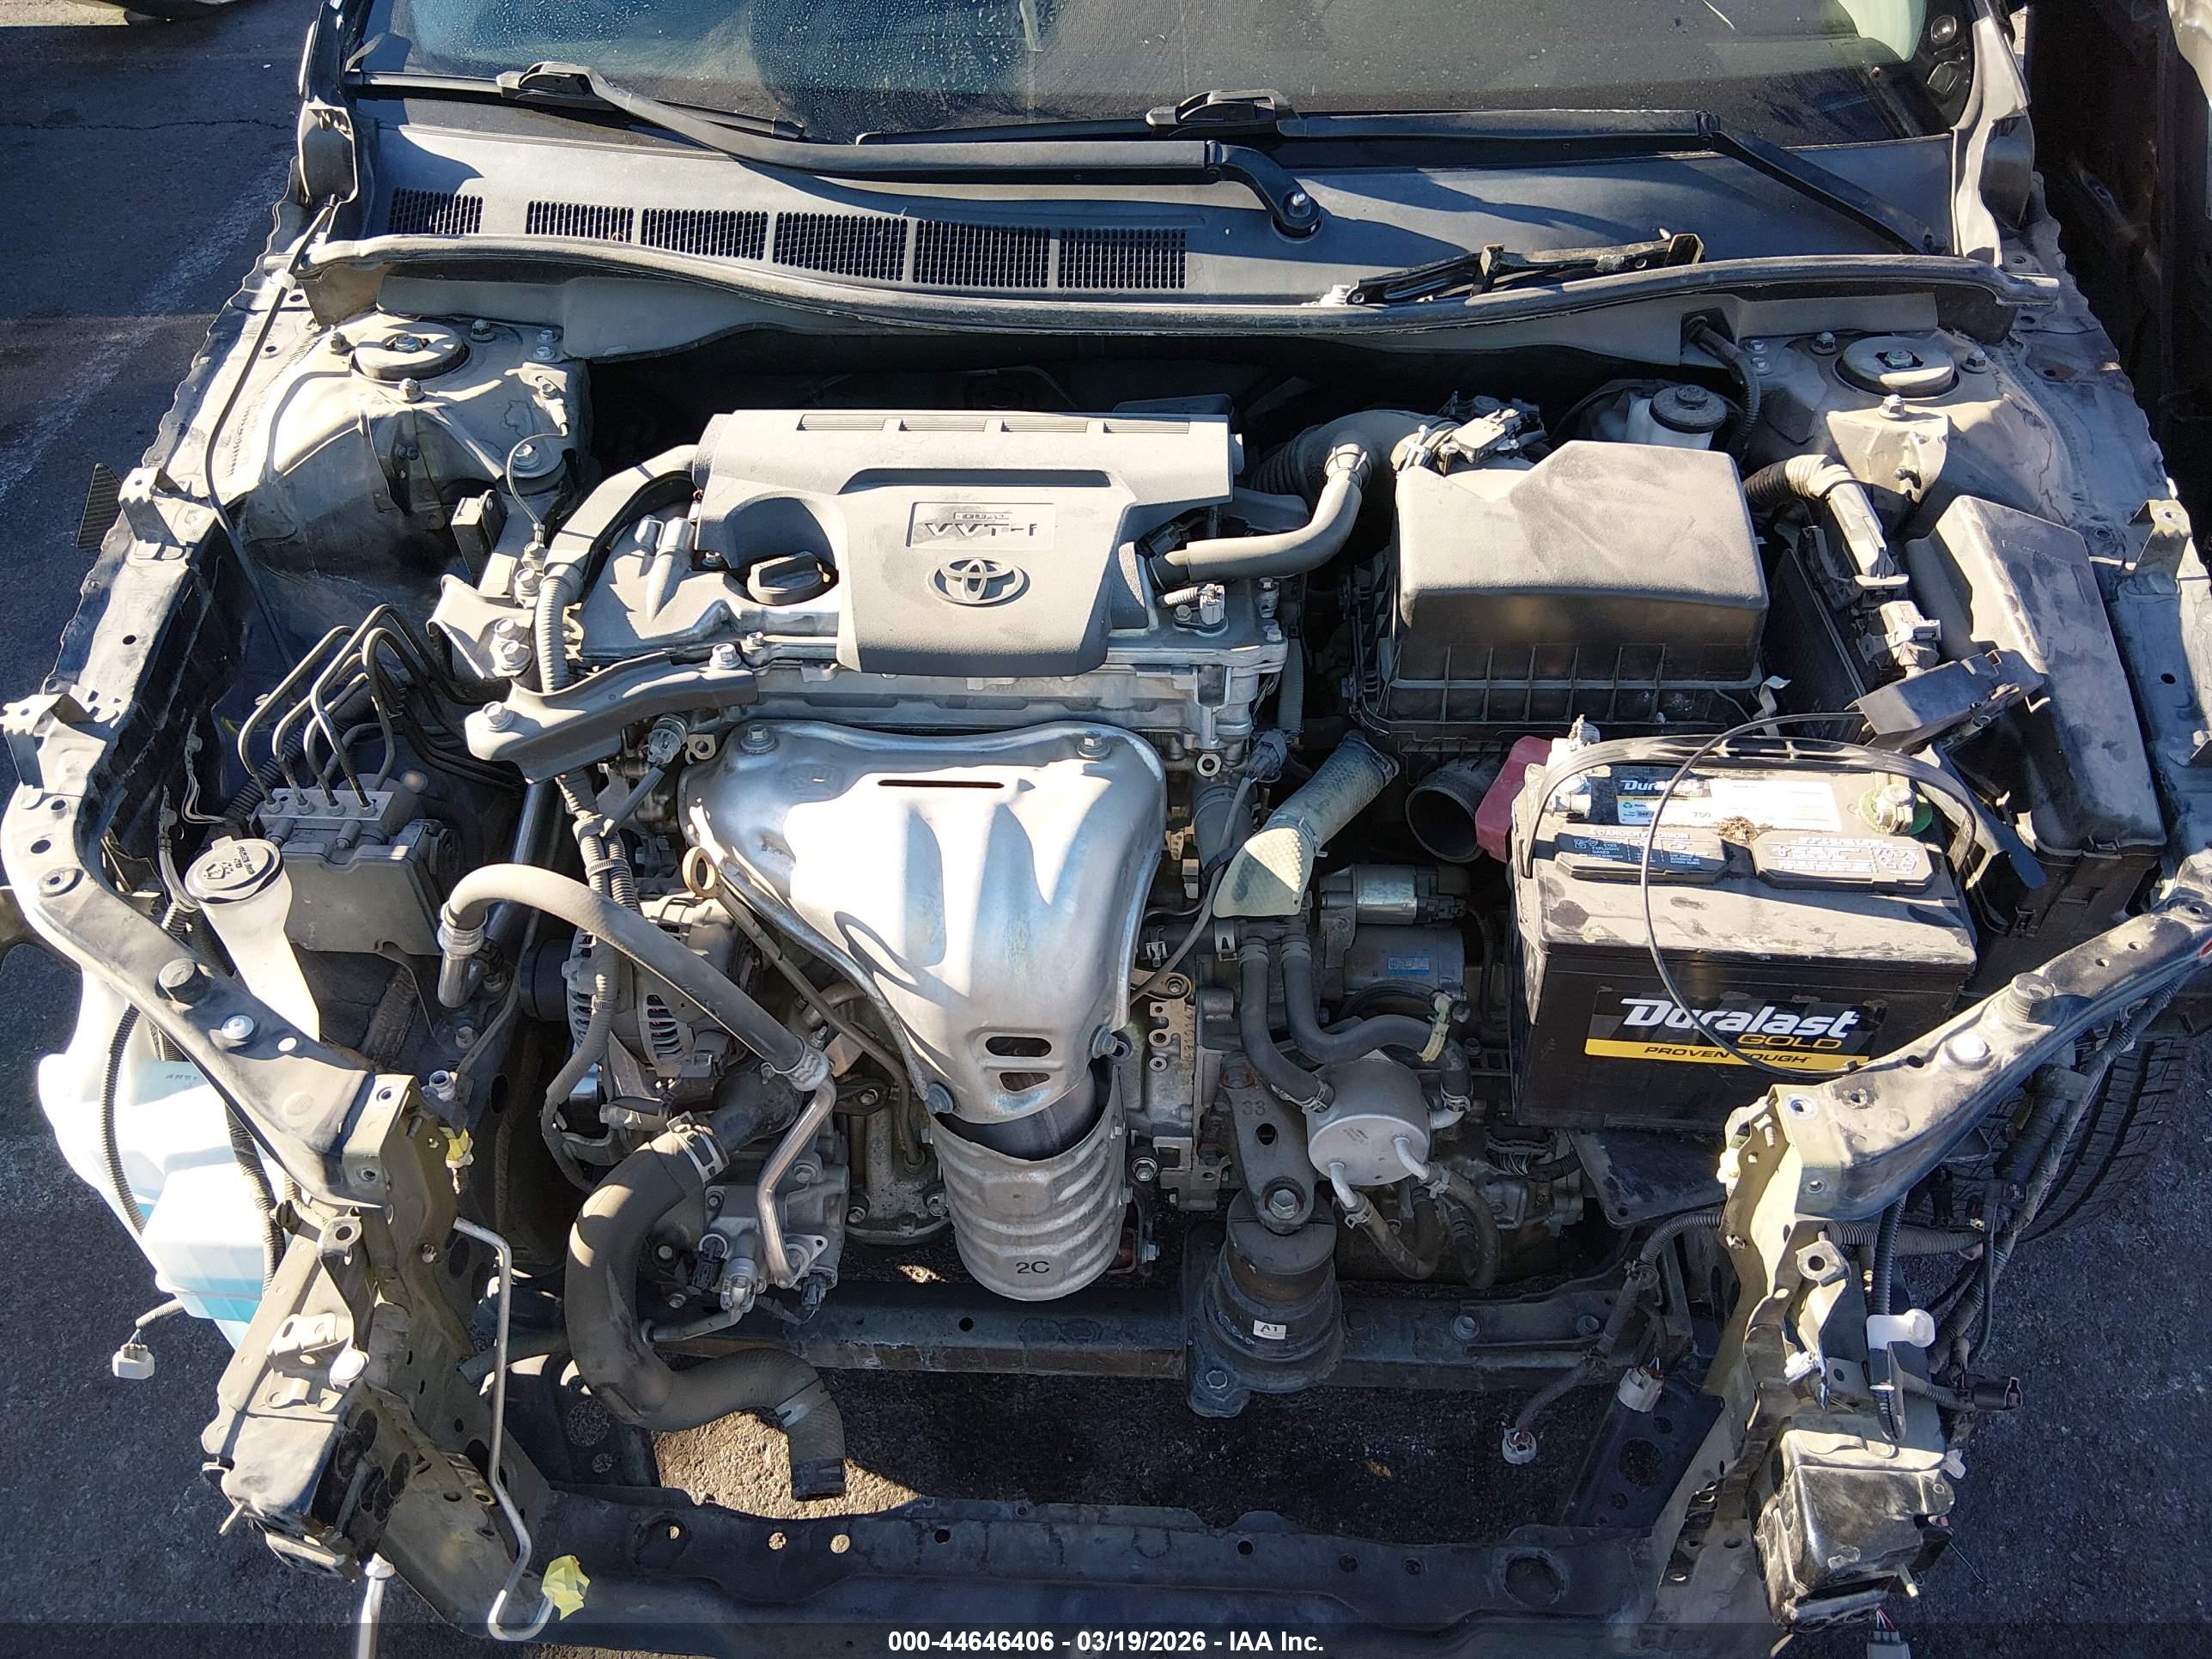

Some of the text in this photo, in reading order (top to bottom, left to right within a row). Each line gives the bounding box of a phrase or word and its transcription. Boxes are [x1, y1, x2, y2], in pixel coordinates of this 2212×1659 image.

[1620, 780, 1704, 791] Dura
[1621, 999, 1860, 1038] Duralast
[1737, 1034, 1842, 1049] GOLD
[1644, 1046, 1729, 1059] PROVEN
[1243, 1100, 1266, 1116] 33
[1016, 1261, 1050, 1274] 2C
[1261, 1324, 1278, 1333] A1
